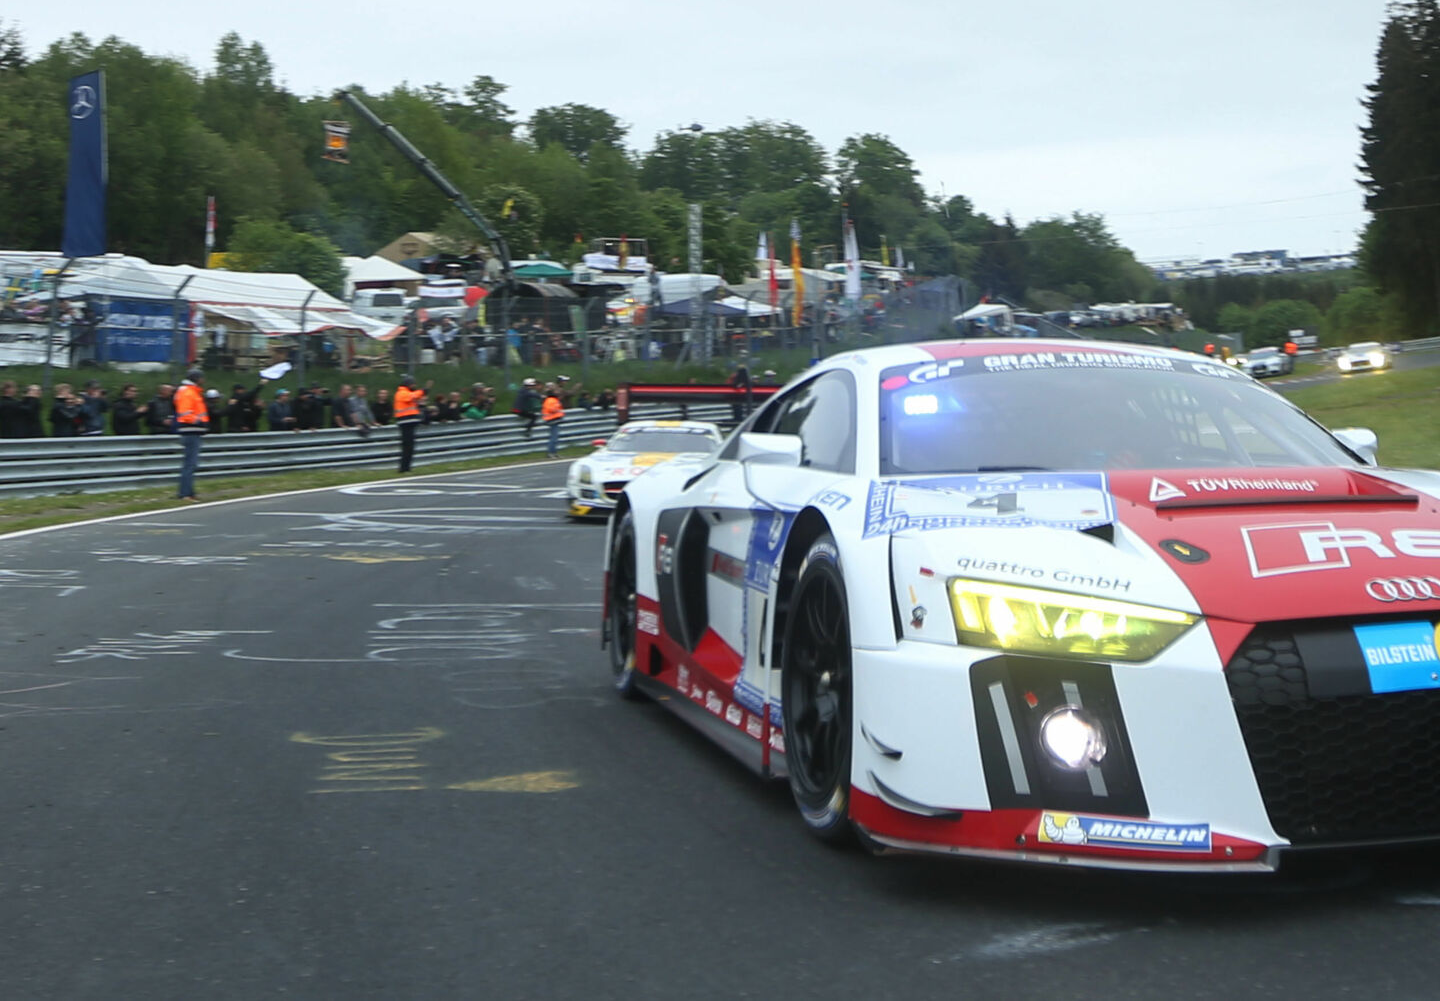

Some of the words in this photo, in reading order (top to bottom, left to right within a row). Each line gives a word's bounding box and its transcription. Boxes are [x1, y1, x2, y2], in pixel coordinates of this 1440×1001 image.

[984, 354, 1055, 368] GRAN
[1061, 351, 1174, 367] TURISMO
[957, 557, 1045, 578] quattro
[1053, 570, 1132, 592] GmbH
[1366, 644, 1437, 666] BILSTEIN
[1089, 821, 1207, 843] MICHELIN
